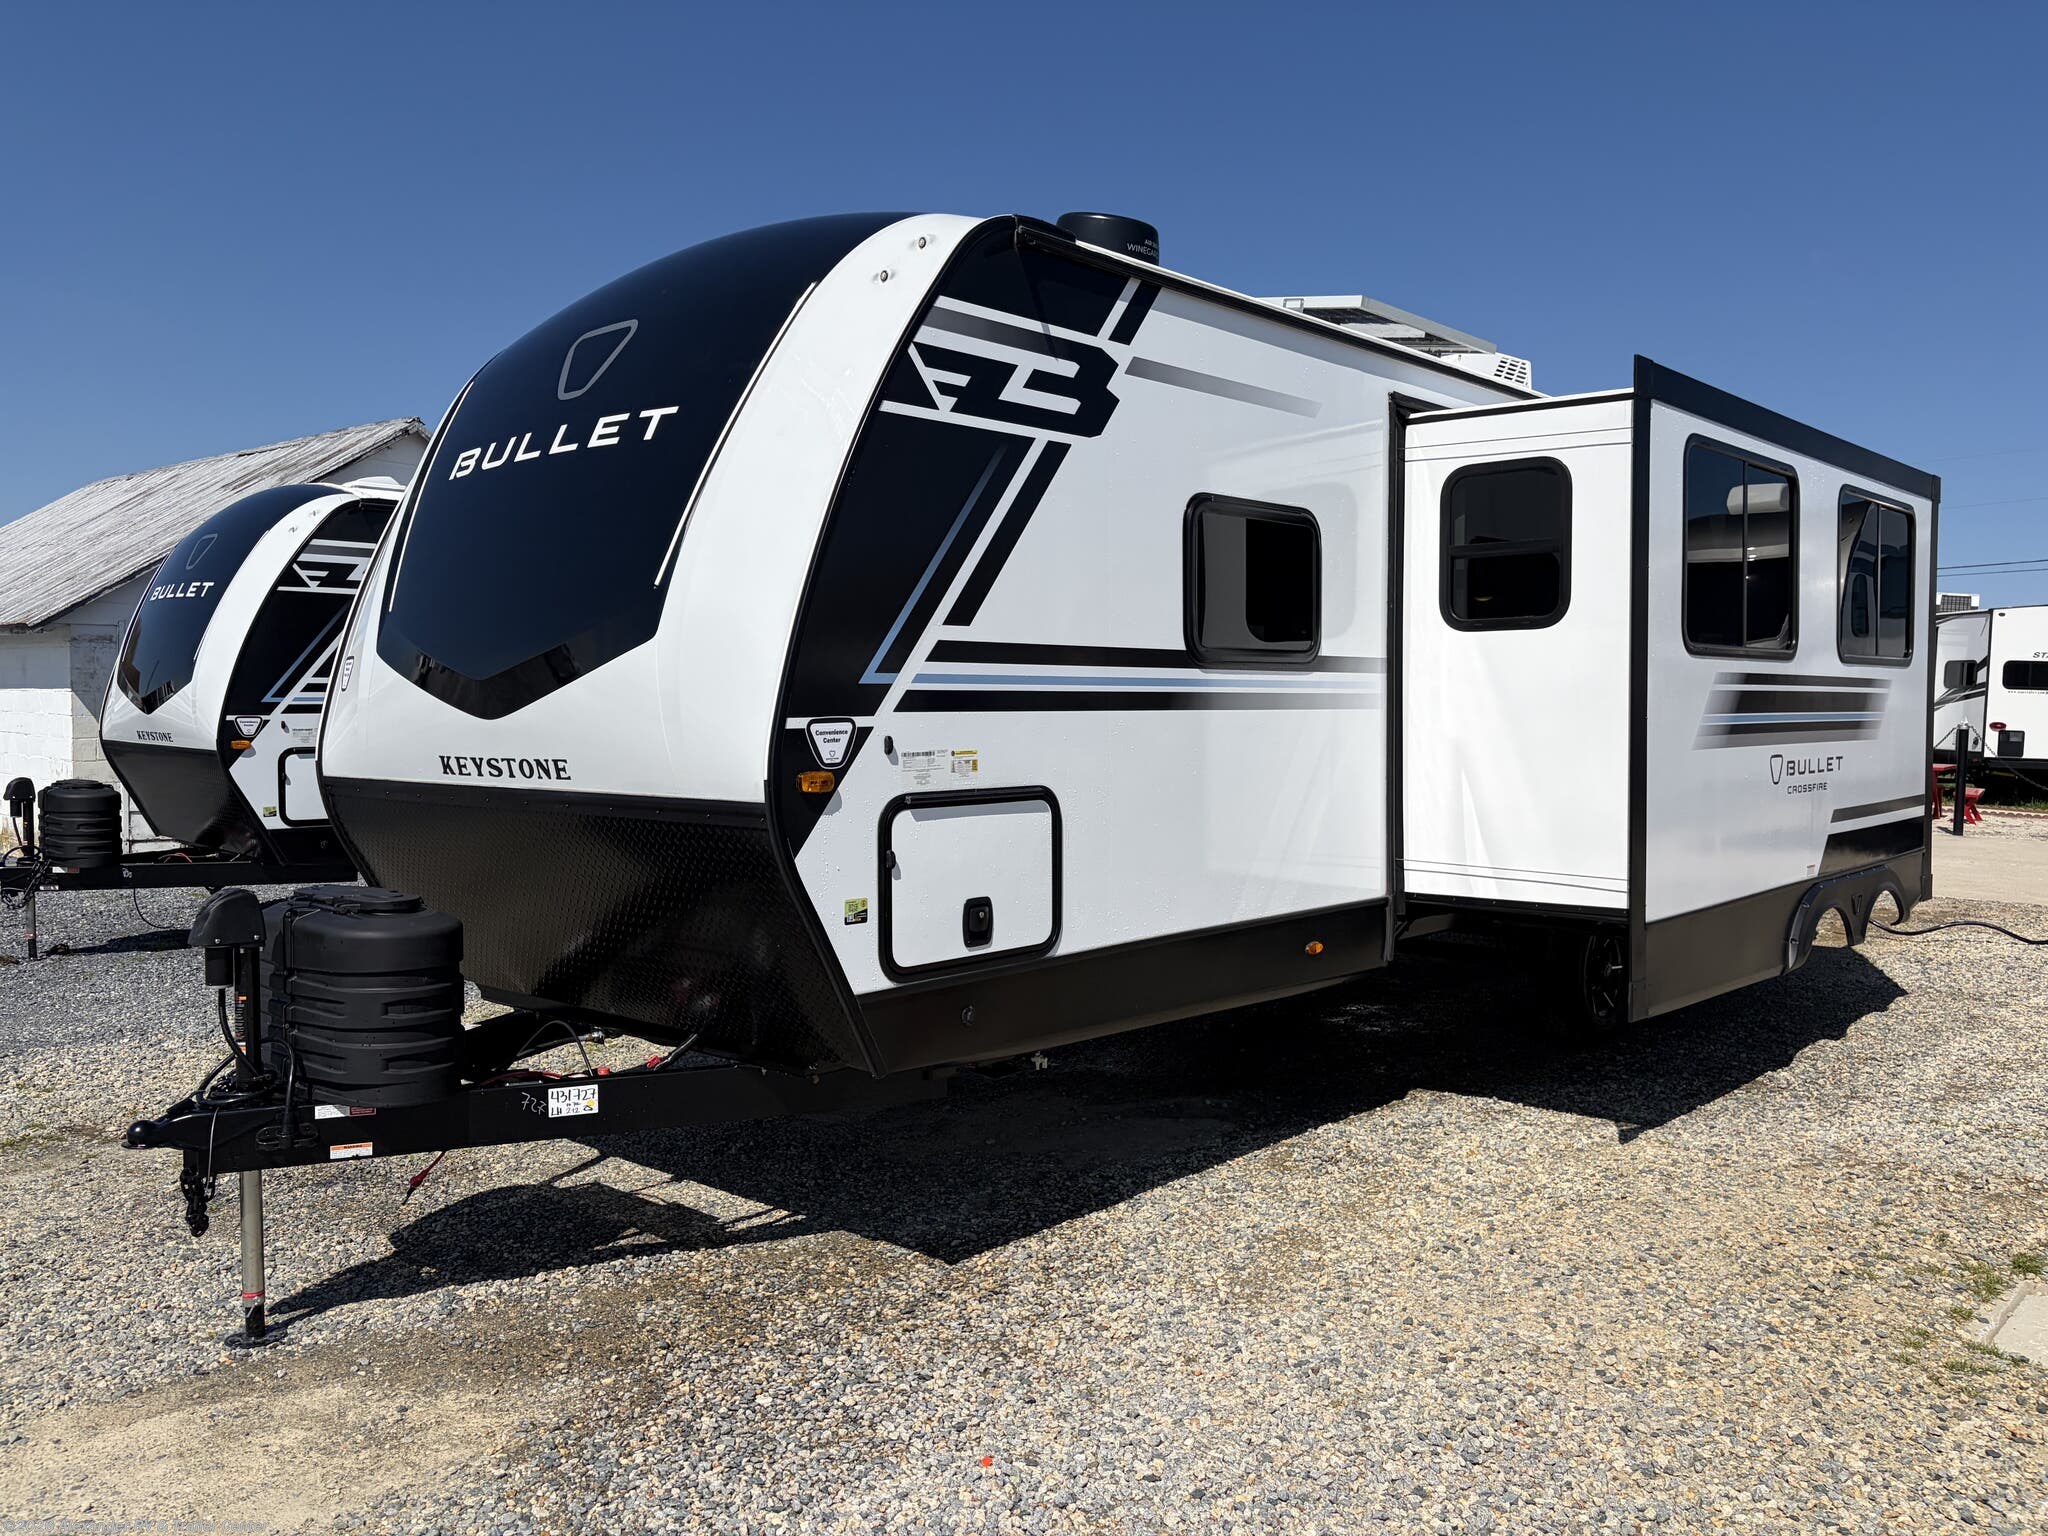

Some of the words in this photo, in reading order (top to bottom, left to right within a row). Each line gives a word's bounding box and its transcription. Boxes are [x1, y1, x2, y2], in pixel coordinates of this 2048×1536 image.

[449, 405, 680, 481] BULLET
[149, 581, 215, 601] BULLET
[2032, 651, 2048, 659] ST
[136, 730, 174, 743] KEYSTONE
[438, 755, 572, 781] KEYSTONE
[1786, 755, 1844, 777] BULLET
[1787, 782, 1828, 795] CROSSFIRE
[550, 1088, 596, 1104] 431727
